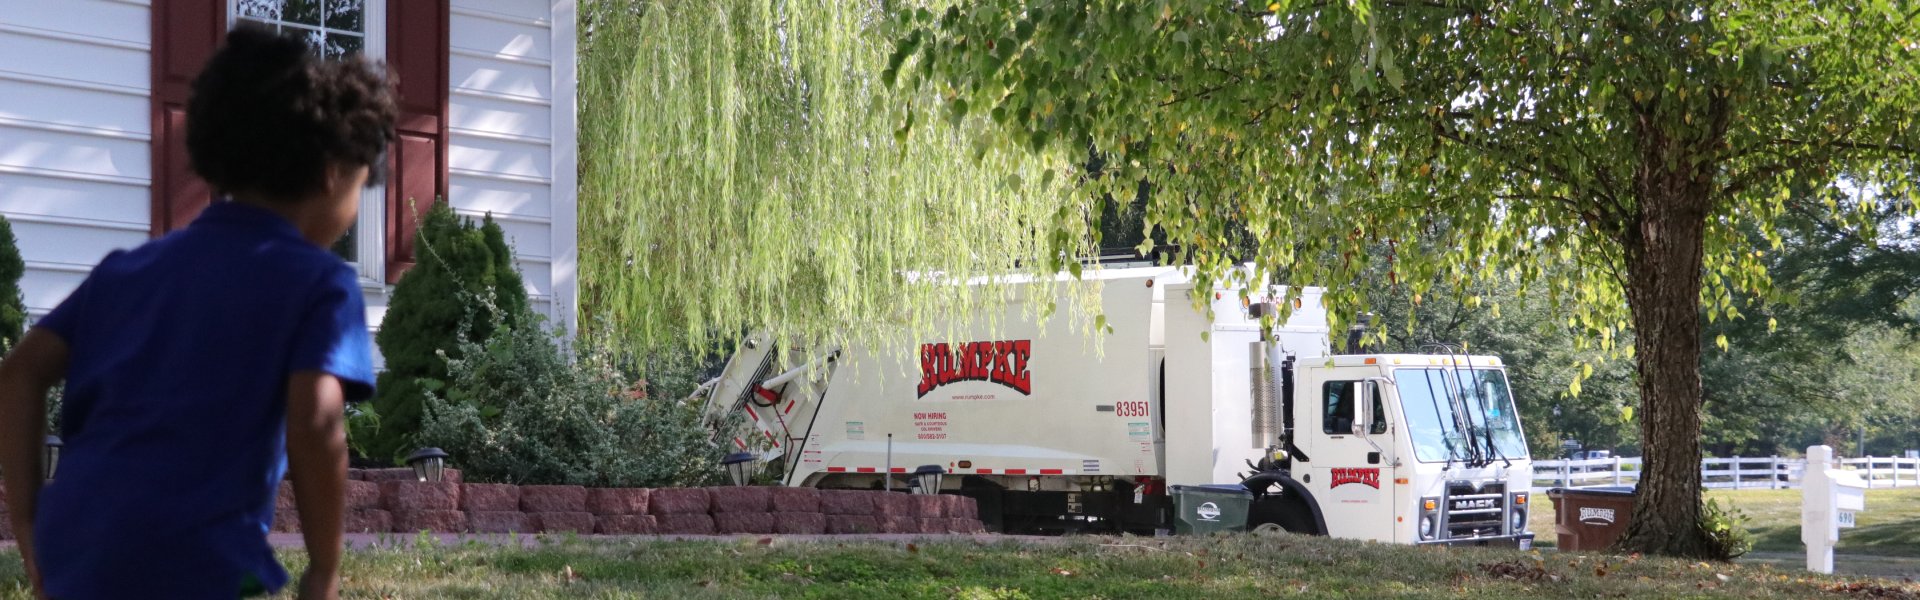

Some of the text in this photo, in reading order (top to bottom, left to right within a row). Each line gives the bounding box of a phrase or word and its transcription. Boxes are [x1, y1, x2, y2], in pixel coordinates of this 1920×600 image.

[917, 340, 1031, 400] RUMPKE
[913, 412, 947, 420] NOW HIRING
[1116, 401, 1149, 417] 83951
[1330, 467, 1380, 490] RUMPKE
[1455, 499, 1494, 509] MACK
[1839, 511, 1852, 523] 690
